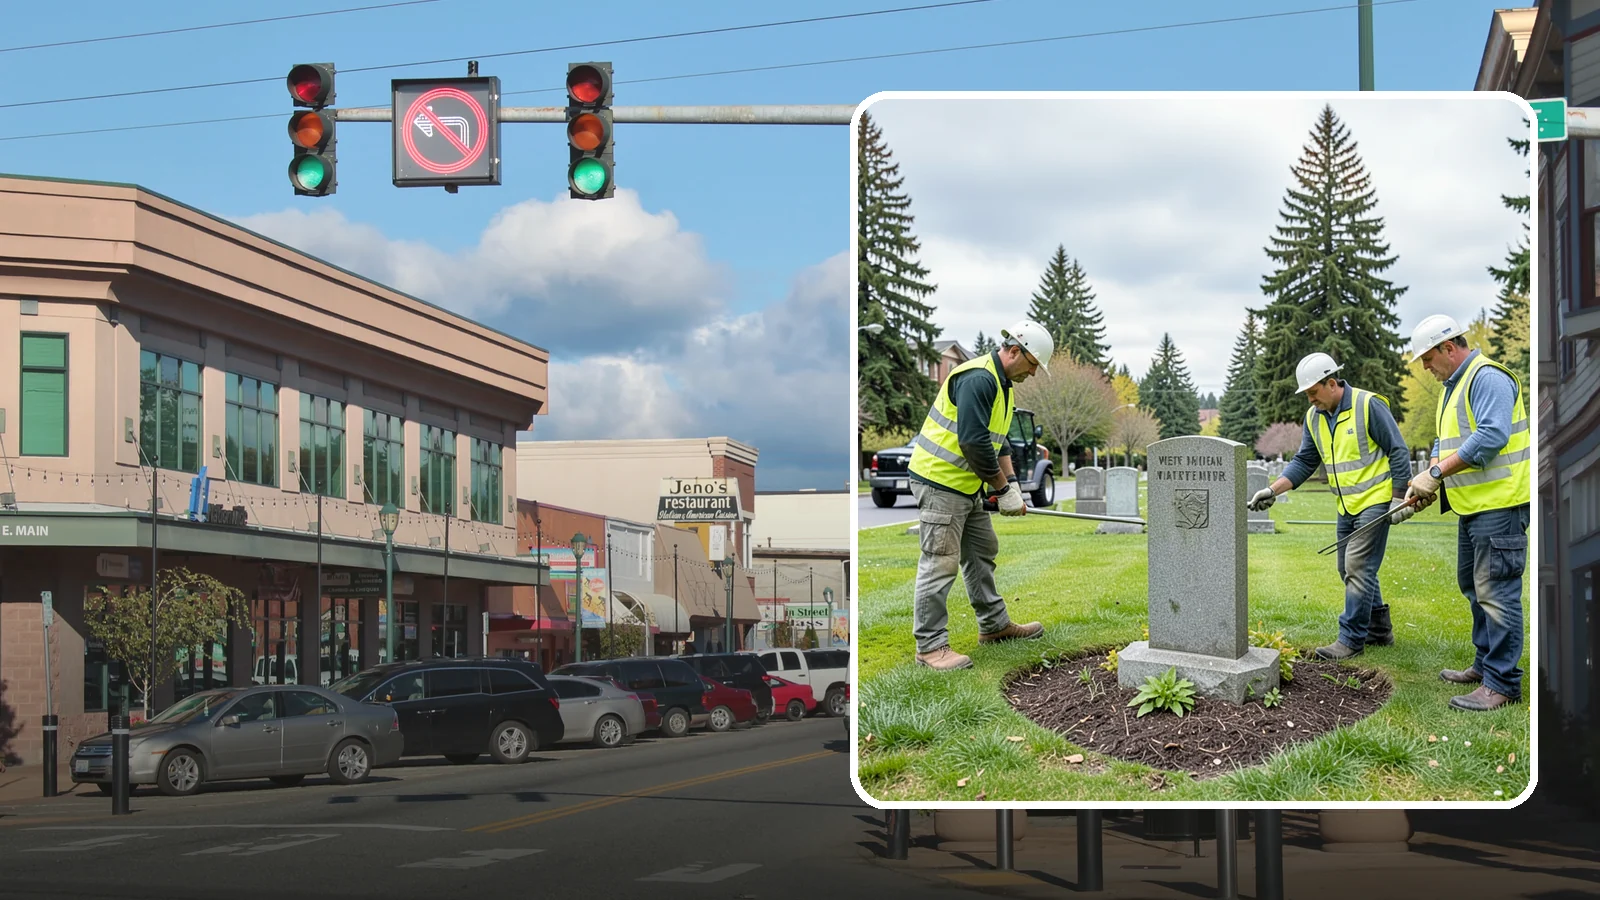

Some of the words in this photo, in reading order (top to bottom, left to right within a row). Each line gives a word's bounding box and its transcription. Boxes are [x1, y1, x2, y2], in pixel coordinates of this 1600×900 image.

[669, 480, 727, 495] Jeno's
[665, 496, 731, 509] restaurant
[658, 510, 681, 519] Italian
[686, 510, 714, 519] American
[714, 510, 738, 519] Cuisine
[2, 525, 13, 536] E.
[15, 525, 49, 536] MAIN
[797, 608, 828, 617] Street
